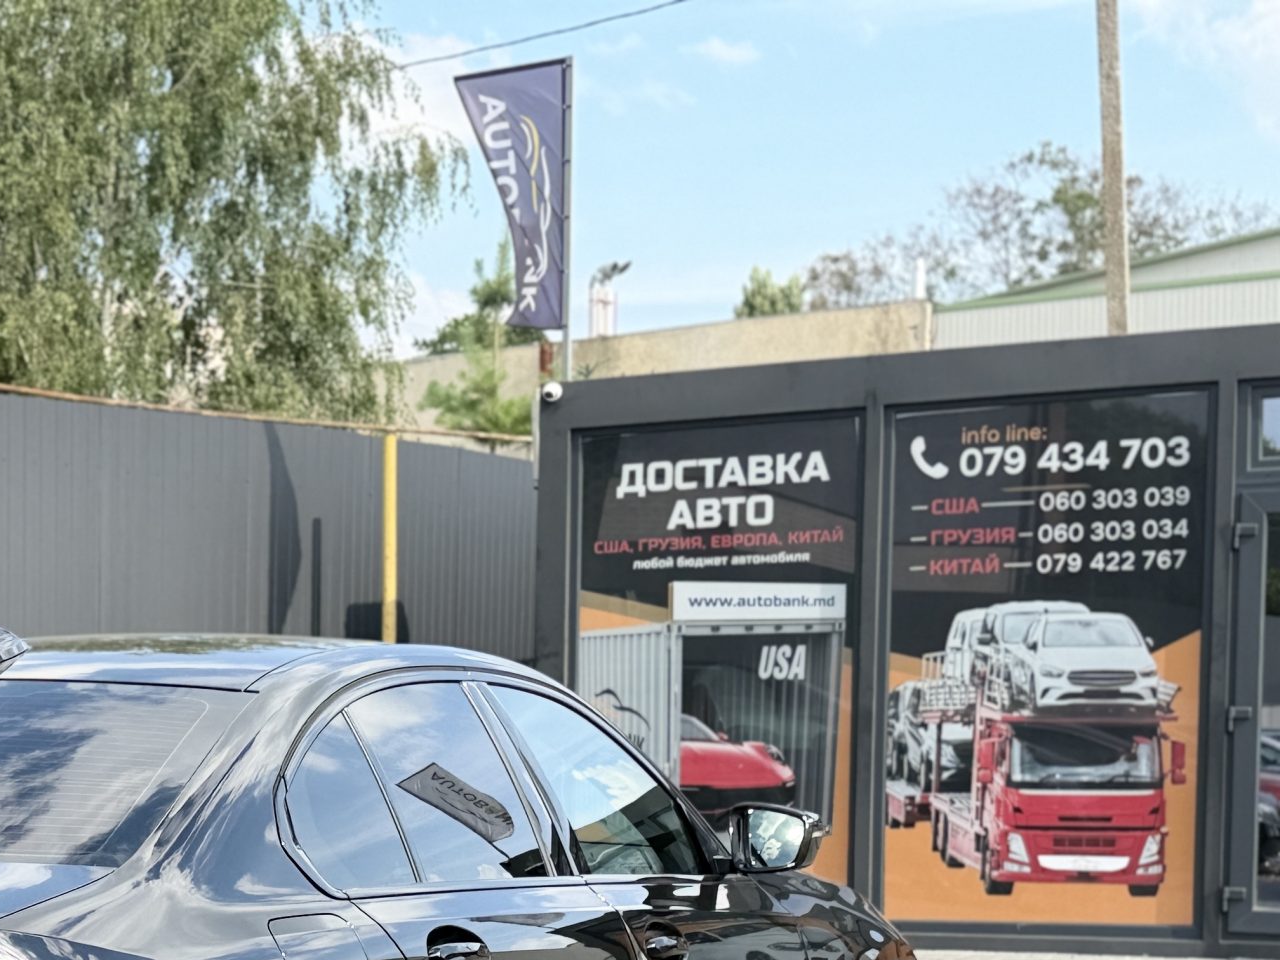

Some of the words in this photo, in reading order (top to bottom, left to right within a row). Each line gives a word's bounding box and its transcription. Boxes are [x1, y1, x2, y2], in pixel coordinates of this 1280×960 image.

[477, 94, 539, 312] AUTONK
[961, 426, 1000, 445] info
[1005, 424, 1048, 442] line:
[959, 445, 1026, 478] 079
[1037, 440, 1110, 473] 434
[1119, 436, 1191, 470] 703
[616, 450, 830, 499] ДОСТАВКА
[666, 494, 774, 530] АВТО
[930, 497, 980, 515] США
[1039, 491, 1086, 512] 060
[1091, 488, 1138, 510] 303
[1143, 486, 1191, 507] 039
[788, 526, 844, 545] КИТАЙ
[930, 527, 1016, 546] ГРУЗИЯ
[1037, 522, 1084, 544] 060
[1090, 520, 1136, 542] 303
[1142, 518, 1189, 539] 034
[633, 556, 674, 570] любой
[677, 554, 728, 569] бюджет
[731, 551, 811, 566] автомобиля
[929, 554, 1000, 575] КИТАЙ
[1036, 553, 1083, 574] 079
[1089, 551, 1135, 572] 422
[1142, 549, 1187, 570] 767
[688, 595, 836, 608] www.autobank.md
[758, 644, 807, 680] USA
